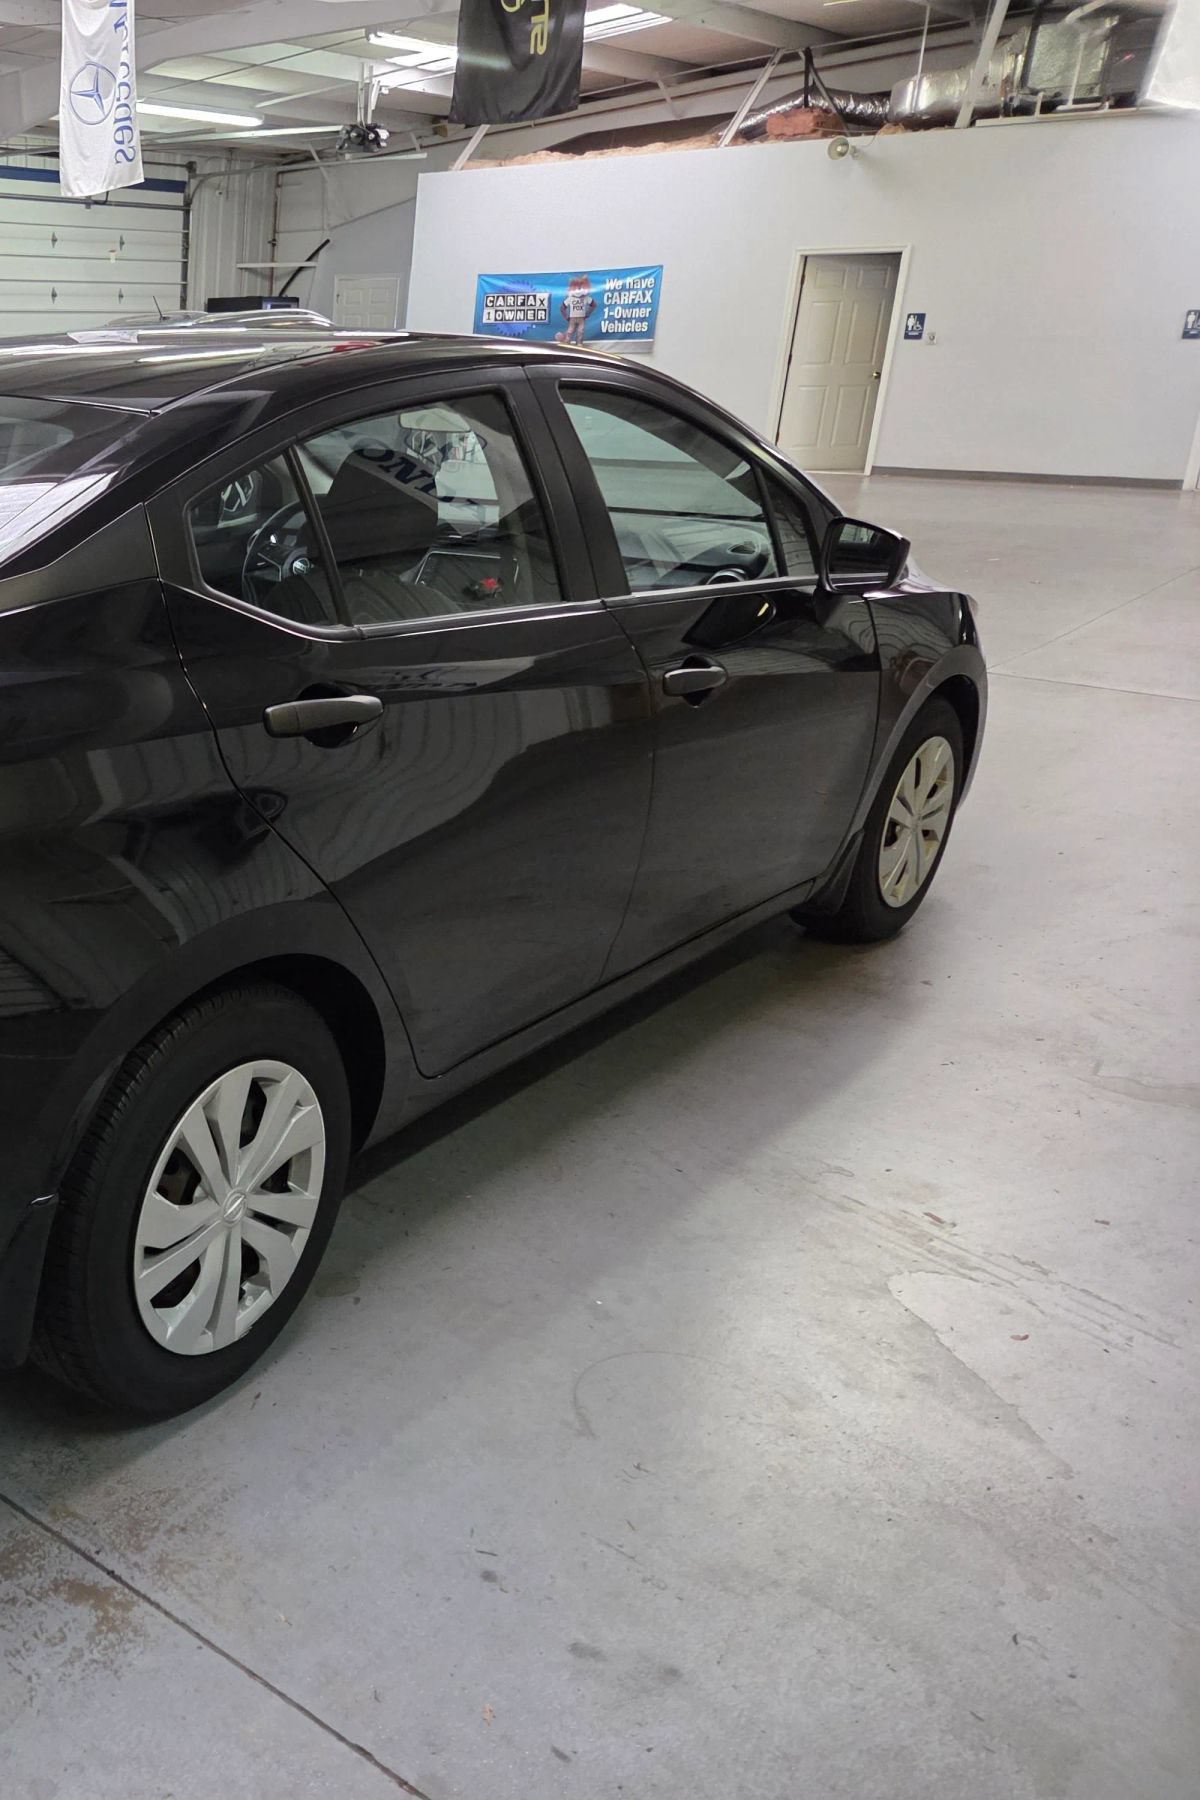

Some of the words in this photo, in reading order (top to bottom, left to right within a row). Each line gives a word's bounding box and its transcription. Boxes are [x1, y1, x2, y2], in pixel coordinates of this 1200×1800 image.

[605, 279, 623, 290] We
[626, 277, 655, 289] have
[486, 296, 545, 306] CARFAX
[604, 290, 653, 305] CARFAX
[495, 310, 545, 320] OWNER
[604, 306, 652, 319] 1-Owner
[601, 319, 649, 333] Vehicles
